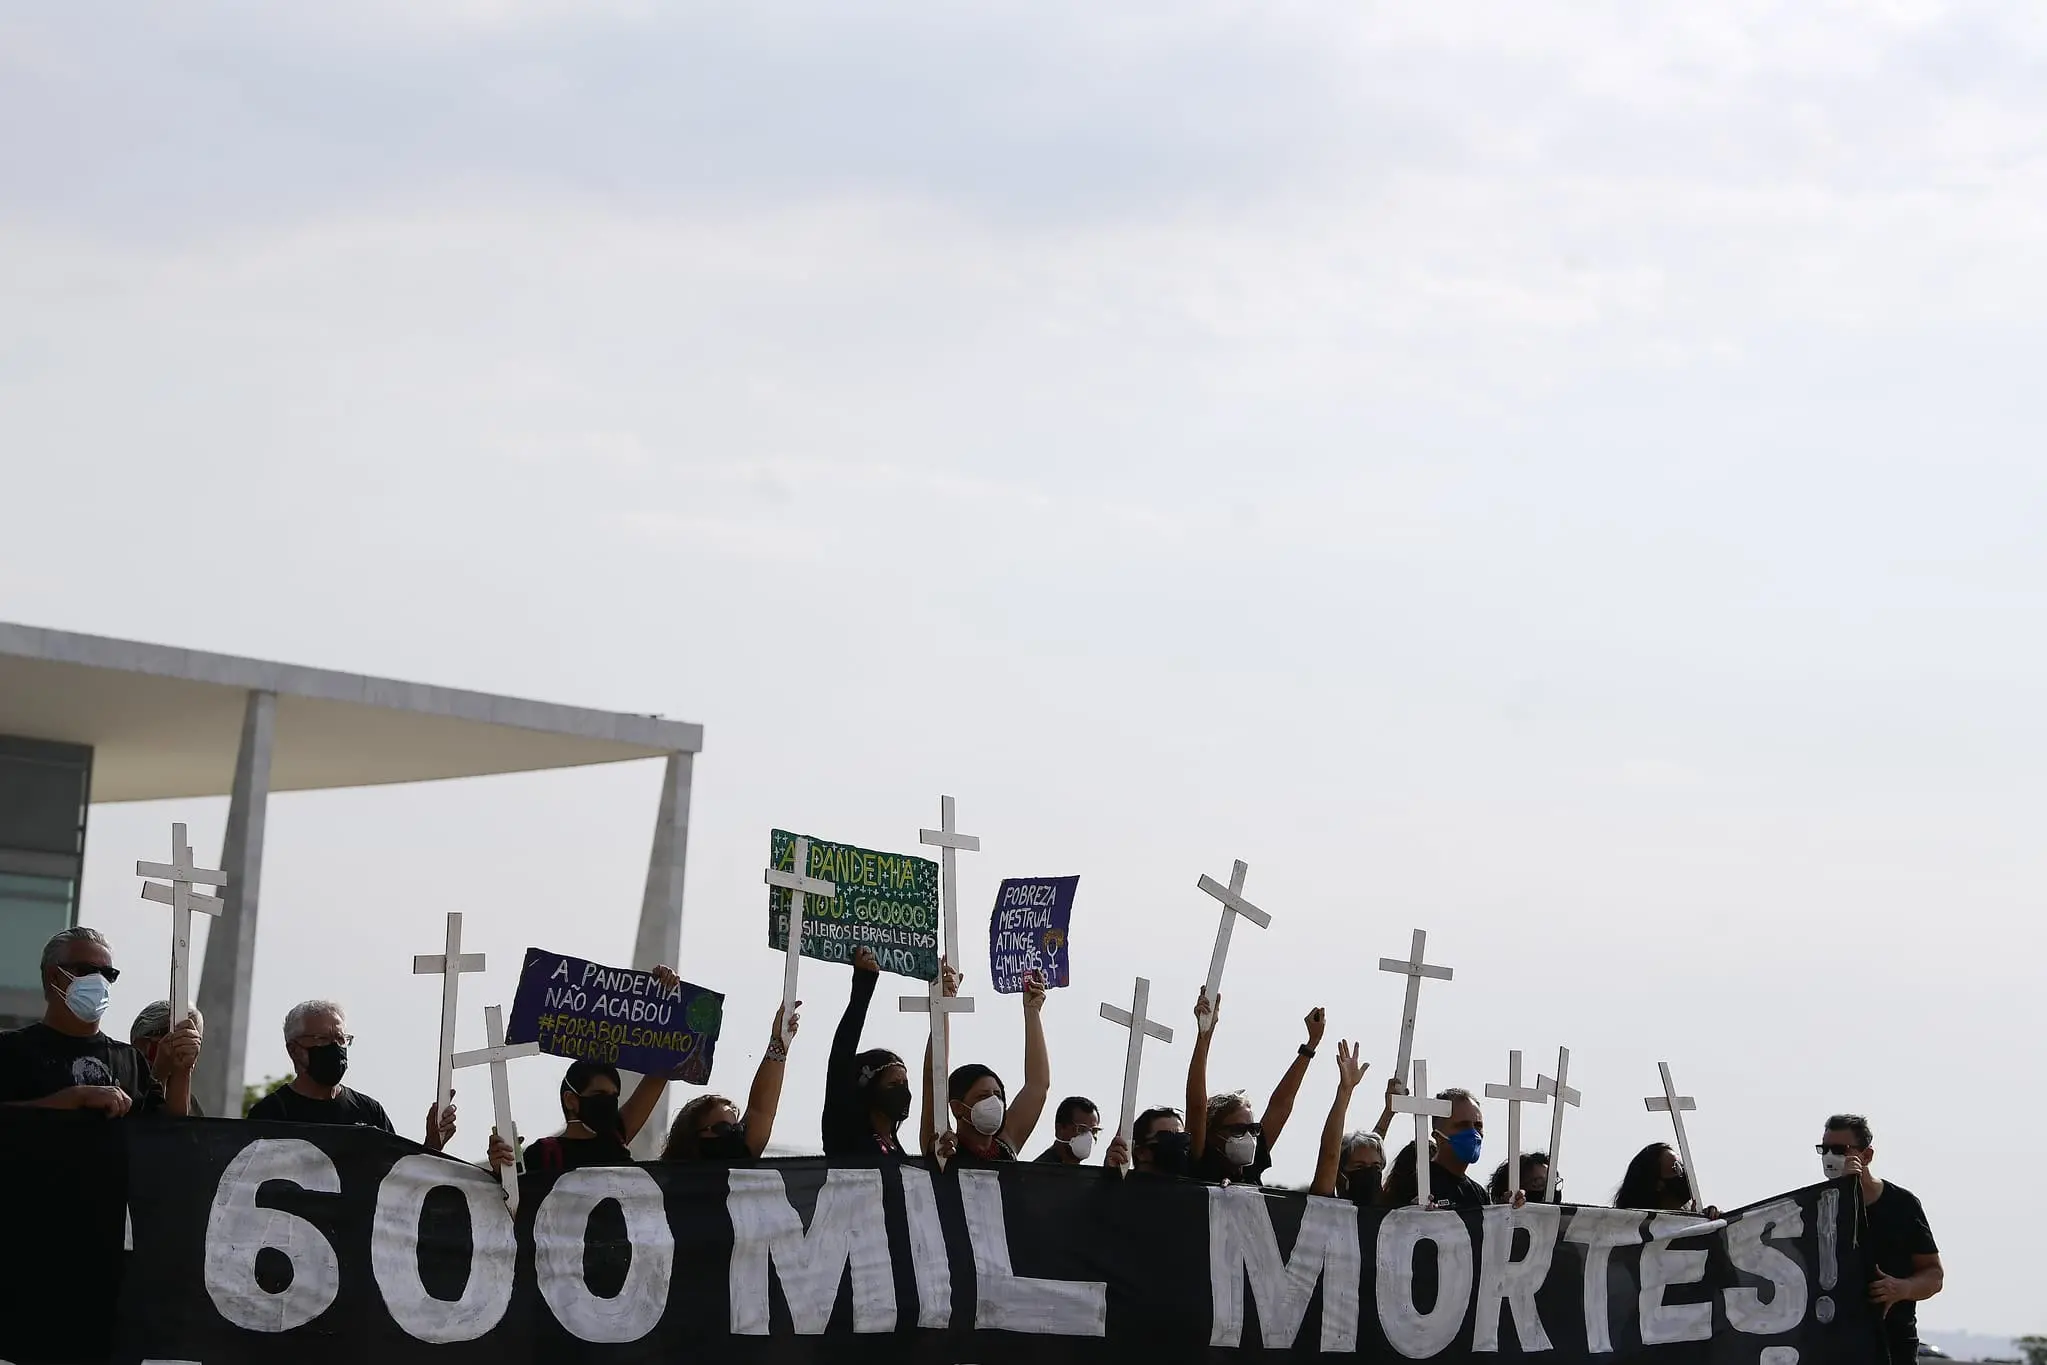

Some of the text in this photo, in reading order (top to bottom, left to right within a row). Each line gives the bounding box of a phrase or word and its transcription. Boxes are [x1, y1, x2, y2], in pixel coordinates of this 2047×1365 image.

[810, 845, 916, 890] PANDEMIA
[854, 897, 927, 928] 600000
[1003, 885, 1057, 906] POBREZA
[999, 907, 1052, 930] MESTRUAL
[996, 932, 1034, 953] ATINGE
[551, 959, 682, 1004] A PANDEMIA
[544, 983, 672, 1026] NÃO ACABOU
[538, 1012, 693, 1053] #FORABOLSONARO
[204, 1138, 1841, 1360] 600 MIL MORTES!
